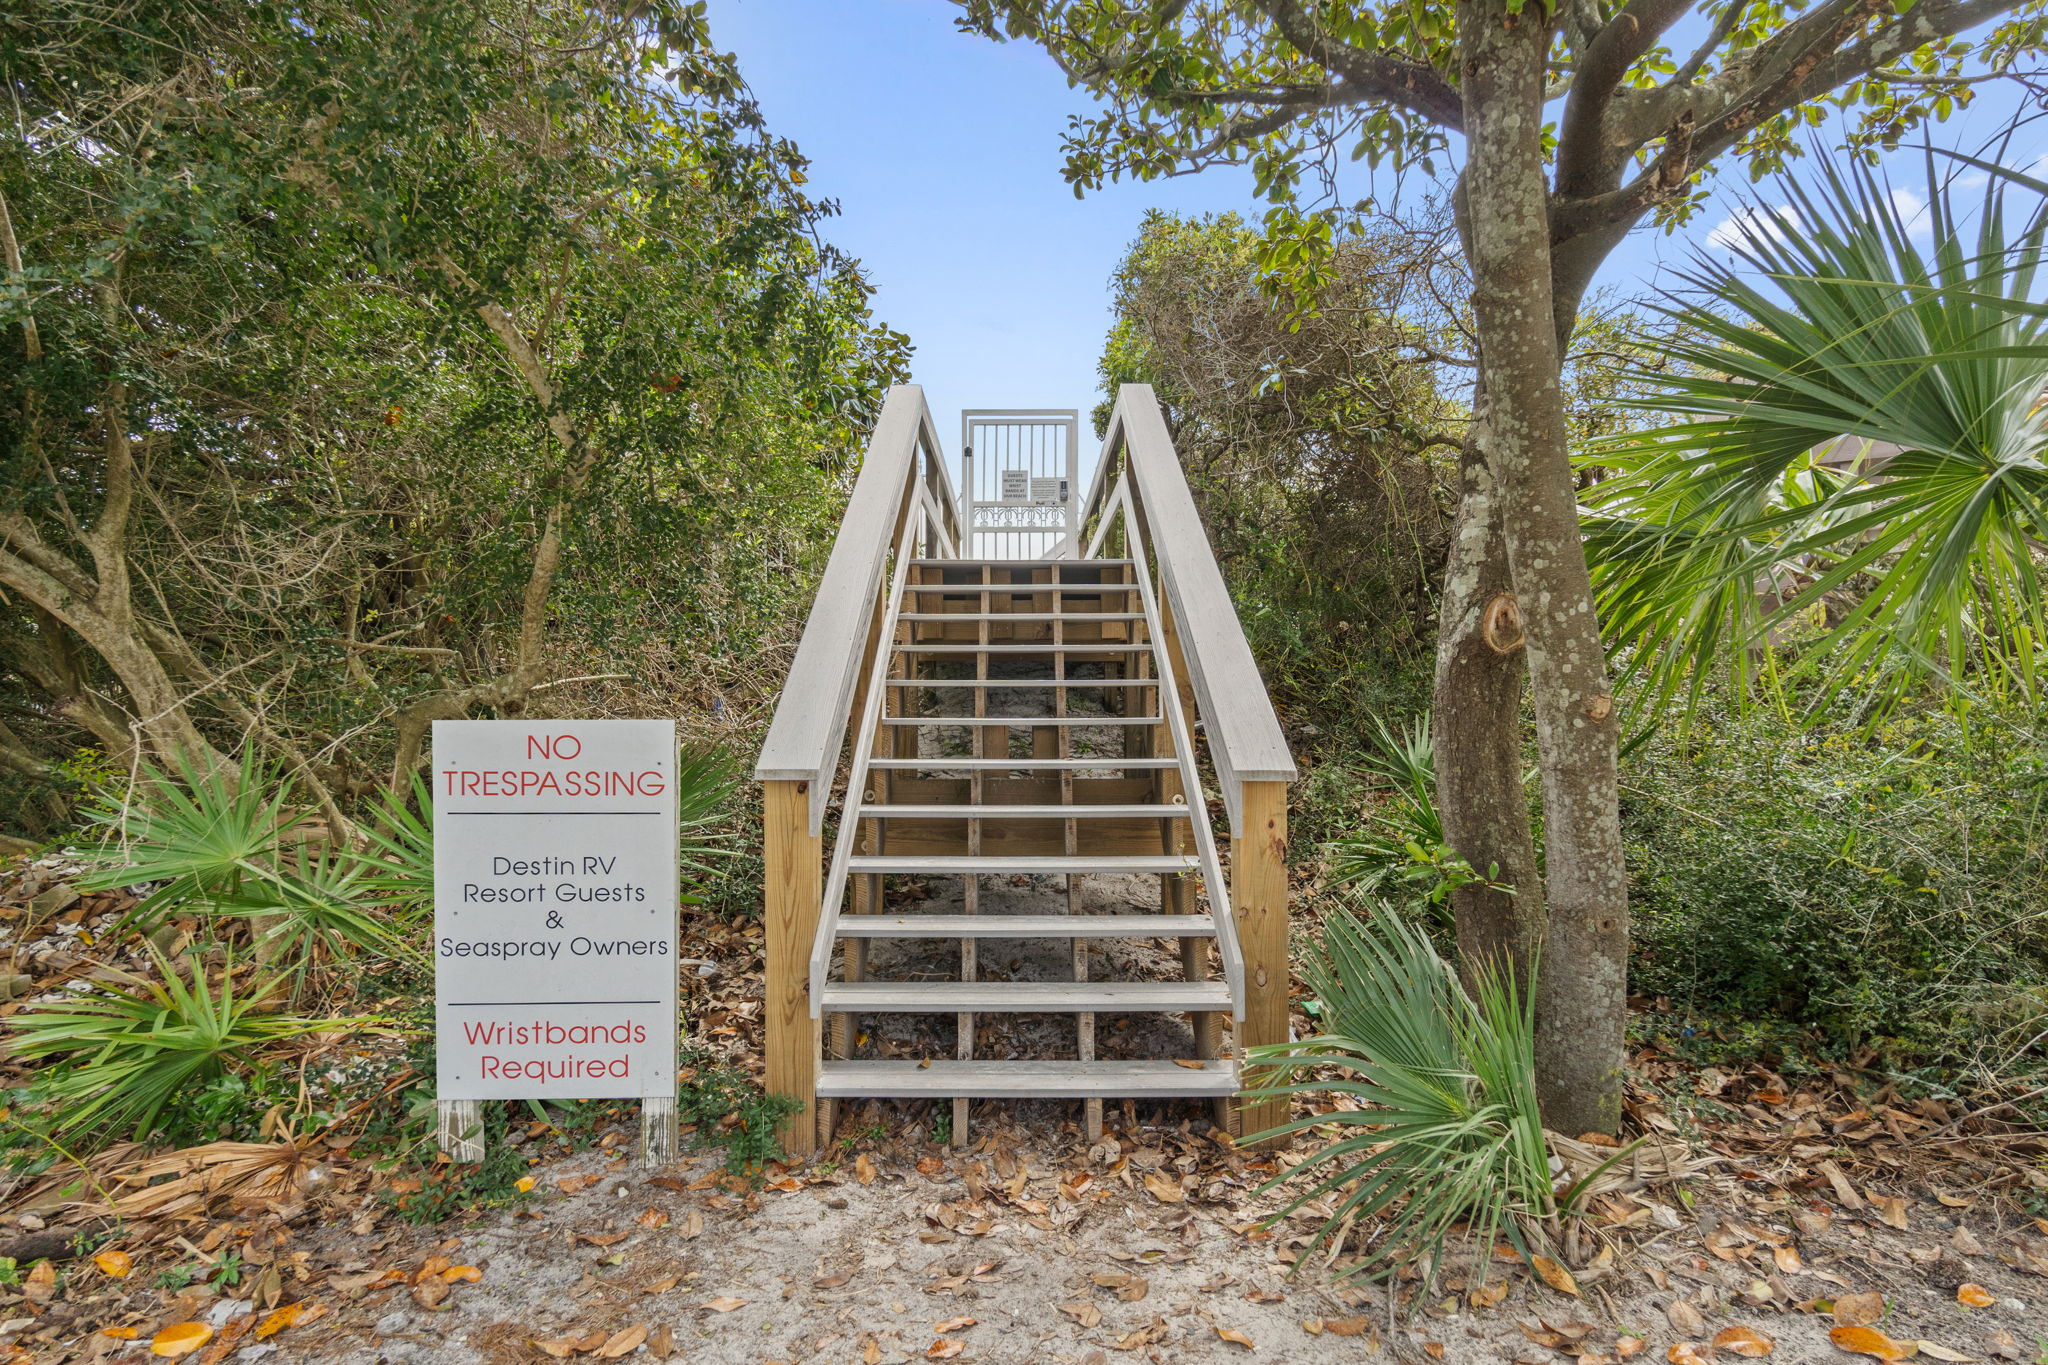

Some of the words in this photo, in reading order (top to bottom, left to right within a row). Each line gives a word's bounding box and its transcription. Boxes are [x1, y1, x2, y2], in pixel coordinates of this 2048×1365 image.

[527, 734, 582, 761] NO
[441, 770, 666, 797] TRESPASSING
[493, 856, 575, 876] Destin
[583, 856, 617, 875] RV
[463, 883, 547, 903] Resort
[555, 882, 646, 903] Guests
[545, 909, 565, 930] &
[440, 937, 562, 961] Seaspray
[570, 936, 668, 957] Owners
[463, 1020, 647, 1046] Wristbands
[481, 1054, 630, 1085] Required
